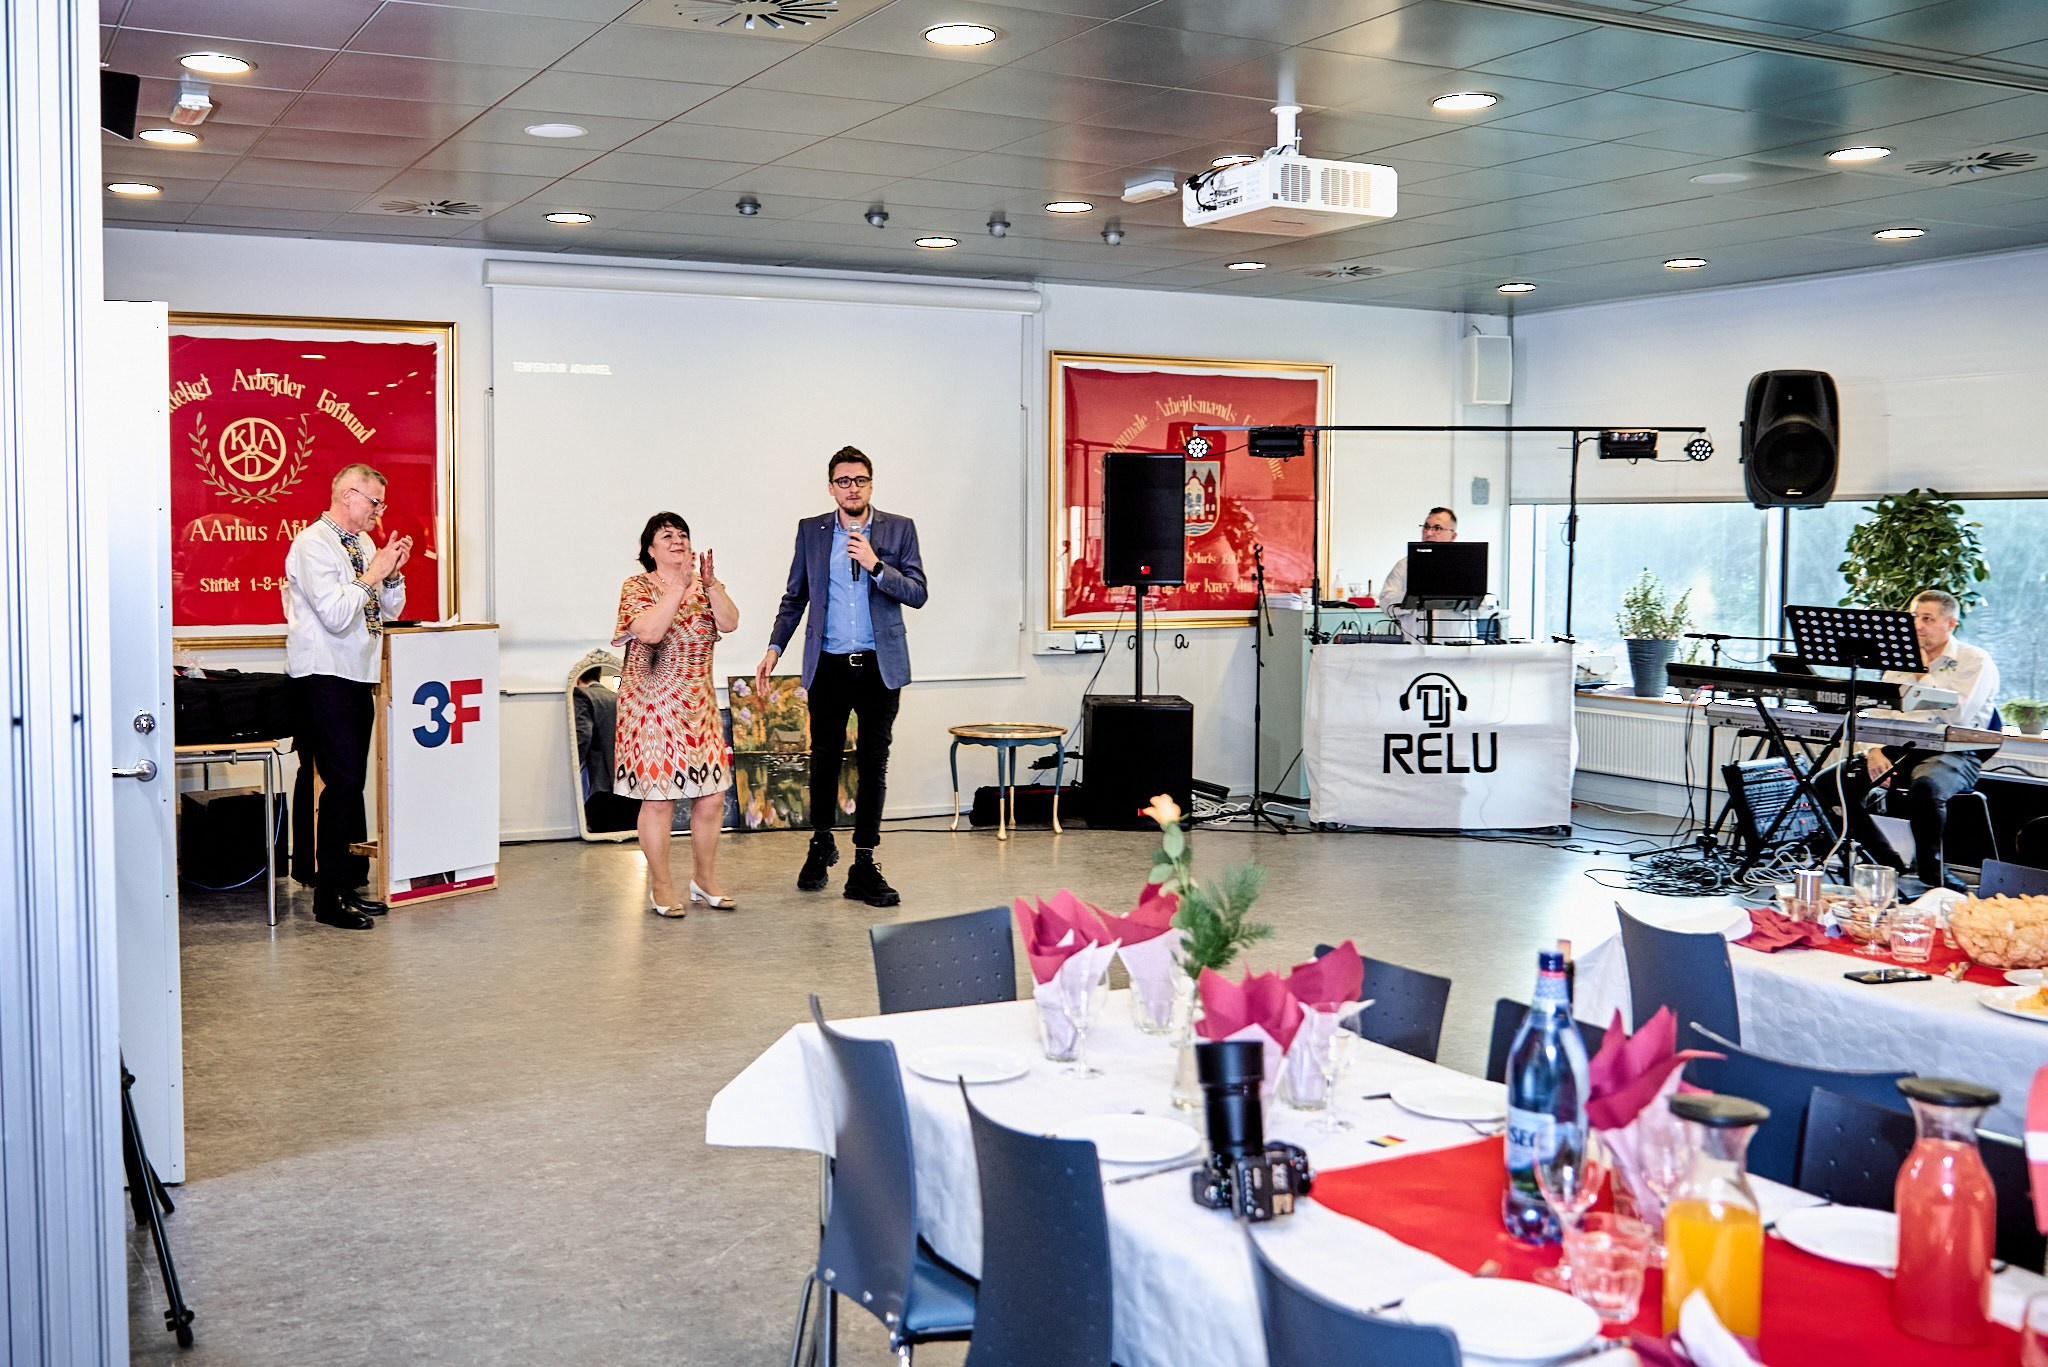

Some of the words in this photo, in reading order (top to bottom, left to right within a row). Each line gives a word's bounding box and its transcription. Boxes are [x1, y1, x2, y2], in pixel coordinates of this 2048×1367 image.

[169, 373, 213, 414] deligt
[231, 368, 306, 399] Arbejder
[316, 388, 377, 443] Forbund
[189, 518, 268, 542] AArhus
[200, 577, 241, 593] Stiftet
[1817, 690, 1847, 705] KORG
[412, 679, 483, 749] 3F
[1810, 728, 1830, 739] KORG
[1383, 732, 1498, 774] RELU
